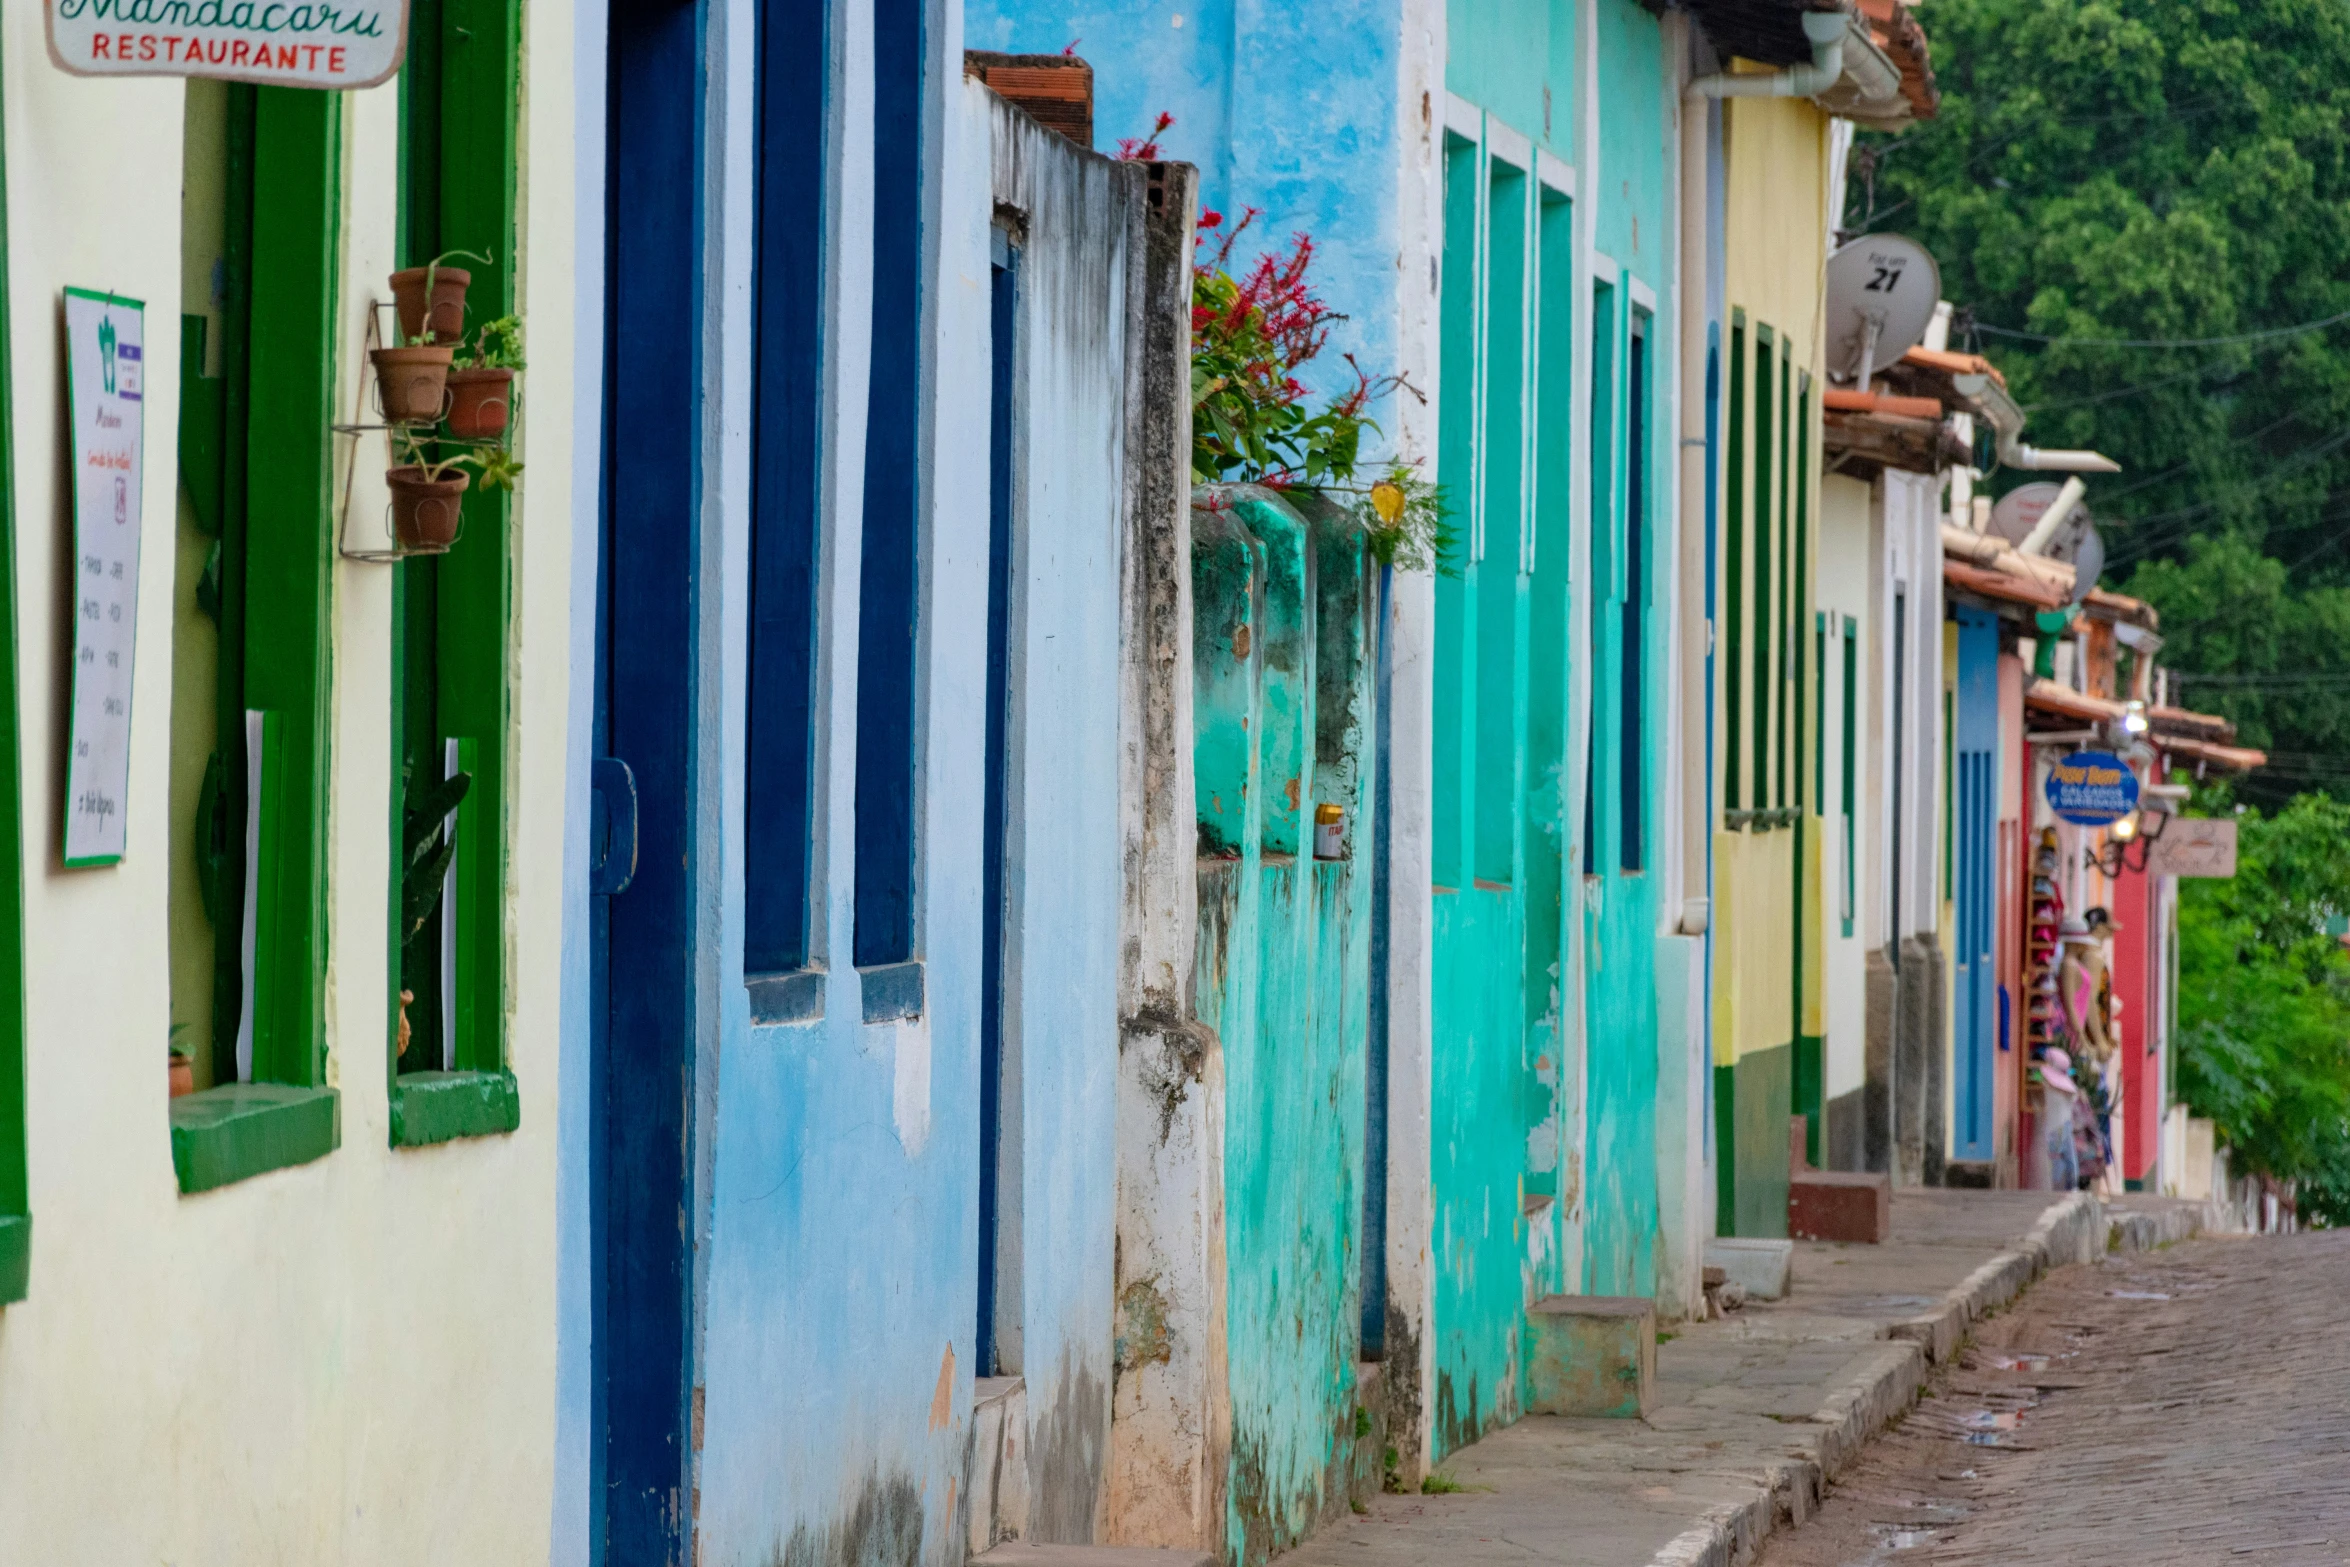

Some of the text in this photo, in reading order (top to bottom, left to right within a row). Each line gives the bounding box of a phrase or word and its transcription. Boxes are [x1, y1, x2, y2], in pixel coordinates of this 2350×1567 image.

[60, 0, 383, 38] Mandacaru
[92, 32, 346, 73] RESTAURANTE
[1864, 267, 1902, 293] 21
